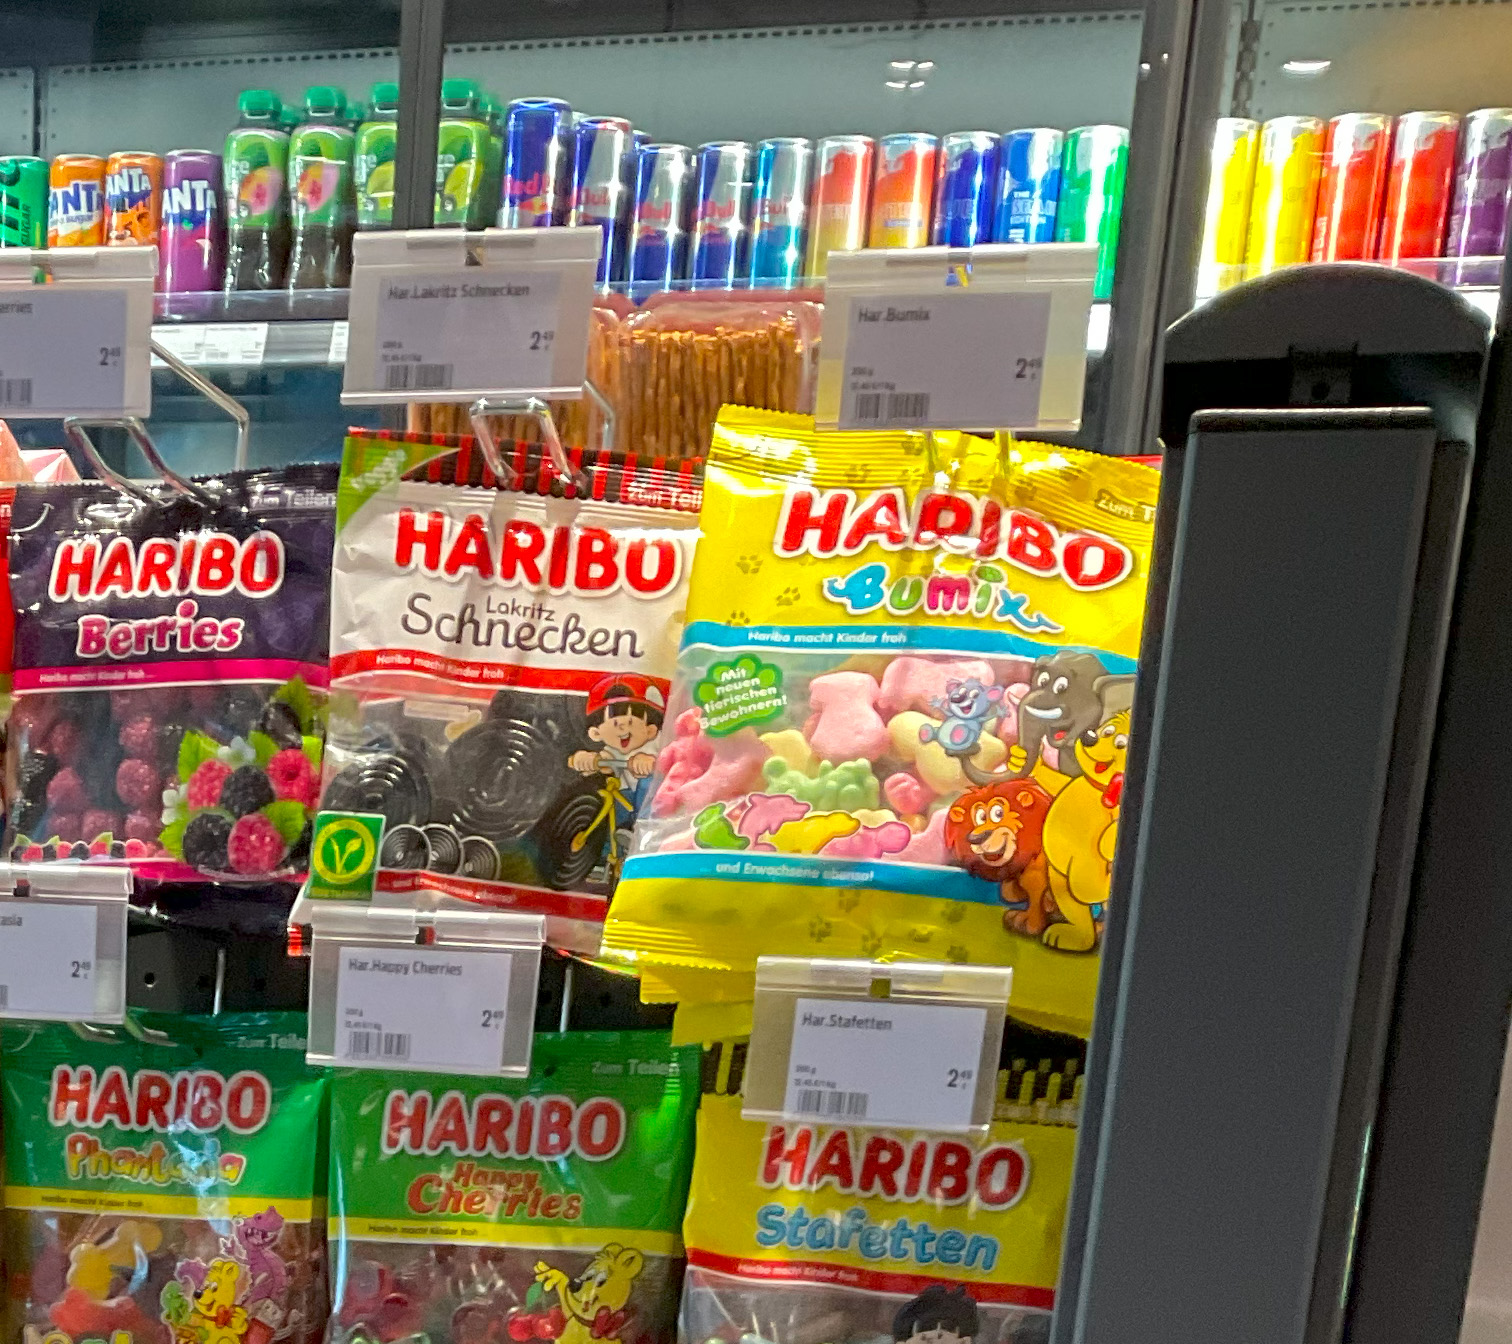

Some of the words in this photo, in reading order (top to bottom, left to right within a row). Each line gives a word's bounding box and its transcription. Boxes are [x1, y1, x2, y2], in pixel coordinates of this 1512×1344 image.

[161, 180, 217, 214] ANTA
[394, 507, 683, 600] HARIBO
[776, 488, 1132, 590] HARIBO
[49, 532, 286, 603] HARIBO
[484, 596, 556, 623] Lakritz
[826, 563, 1063, 633] Bumix
[77, 600, 244, 660] Berries
[401, 593, 644, 659] Schnecken
[748, 630, 791, 643] Haribo
[793, 631, 834, 644] macht
[836, 631, 878, 644] Kinder
[880, 632, 907, 645] froh
[704, 684, 777, 713] tierischen
[715, 676, 761, 696] neuen
[701, 695, 788, 729] Bewohnern!
[716, 862, 740, 874] und
[743, 863, 820, 880] Erwachsene
[348, 958, 410, 977] Har.Happy
[412, 961, 463, 977] Cherries
[801, 1012, 893, 1033] Har.Stafetten
[50, 1064, 273, 1135] HARIBO
[382, 1089, 627, 1162] HARIBO
[449, 1160, 540, 1196] Happy
[757, 1122, 1032, 1211] HARIBO
[406, 1171, 582, 1222] Cherries
[755, 1204, 1001, 1272] Stafetten
